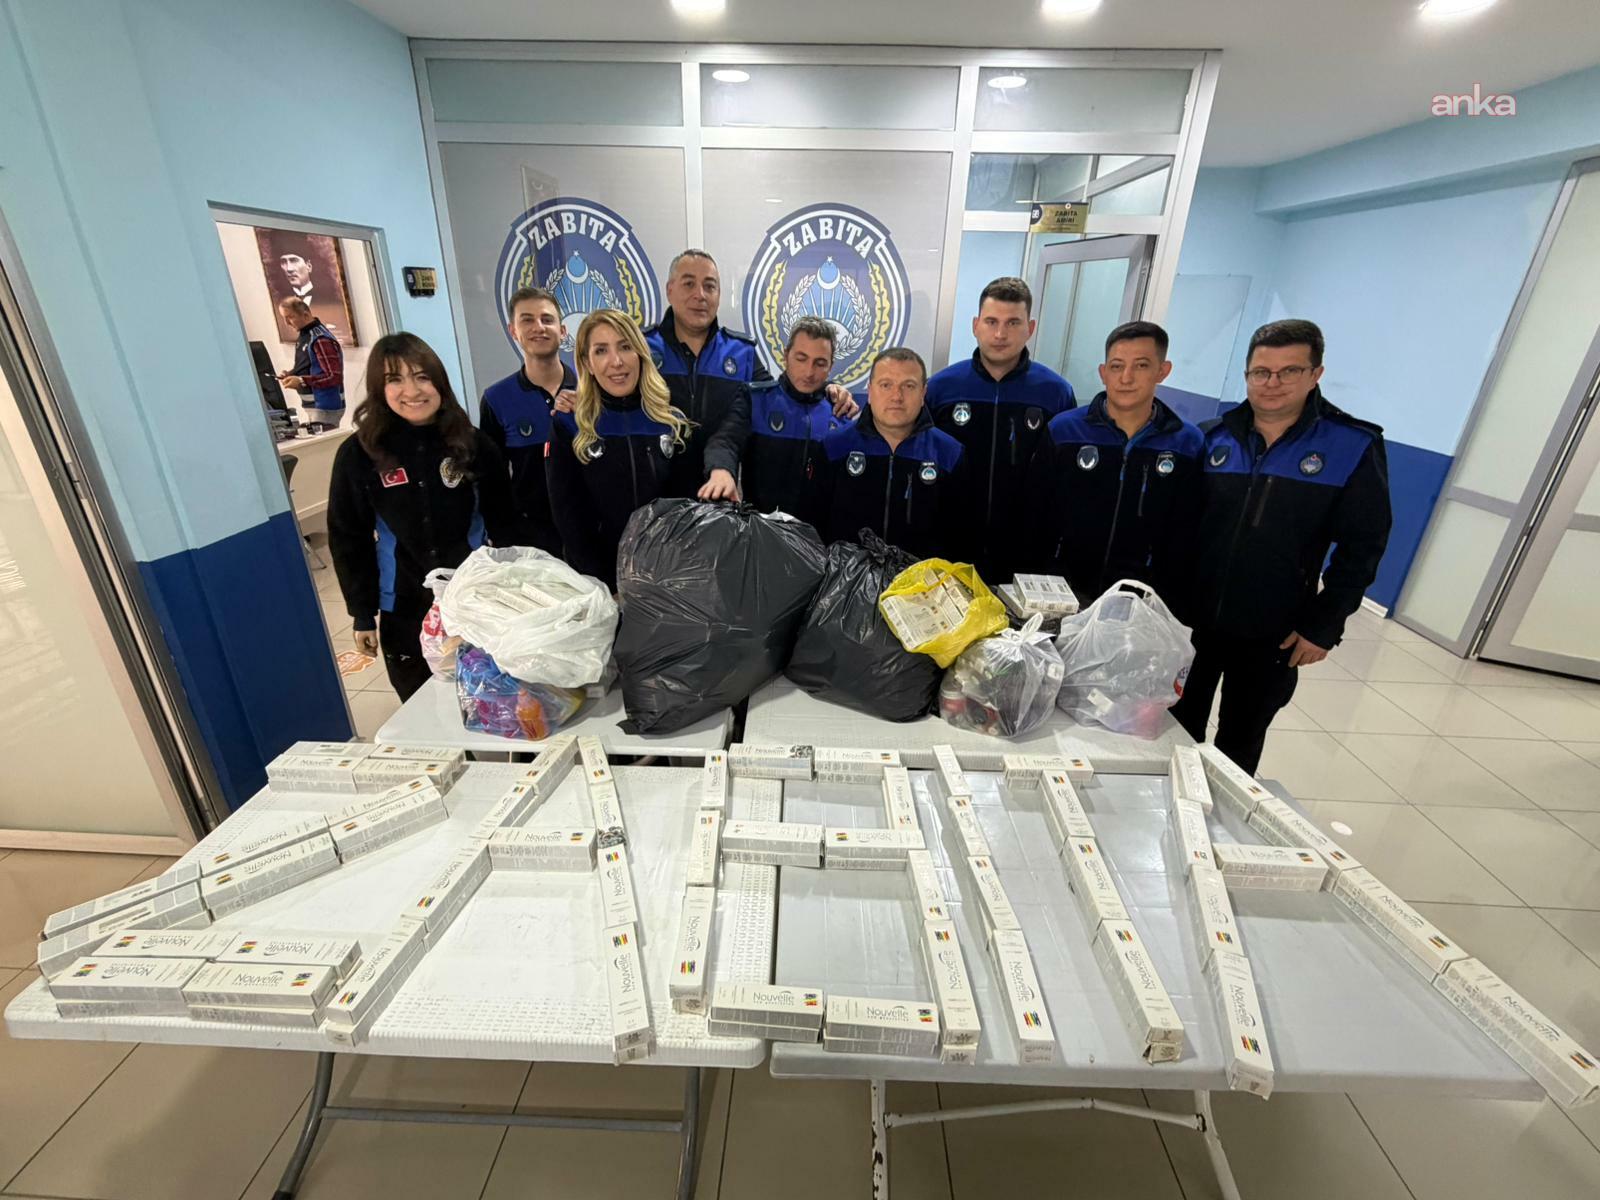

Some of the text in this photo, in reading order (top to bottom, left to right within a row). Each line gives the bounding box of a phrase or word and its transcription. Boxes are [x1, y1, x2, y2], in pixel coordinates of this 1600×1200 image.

[528, 212, 617, 253] ZABITA
[782, 217, 874, 259] ZABITA
[607, 867, 622, 896] Nouvelle
[264, 943, 311, 956] Nouvelle
[688, 916, 700, 952] Nouvelle
[102, 963, 152, 979] Nouvelle
[234, 971, 283, 986] Nouvelle
[614, 953, 631, 994] Nouvelle
[1013, 961, 1035, 1002] Nouvelle
[1124, 951, 1152, 990] Nouvelle
[753, 990, 795, 1003] Nouvelle
[867, 1005, 909, 1019] Nouvelle
[1234, 985, 1256, 1028] Nouvelle
[1503, 996, 1560, 1041] Nouvelle
